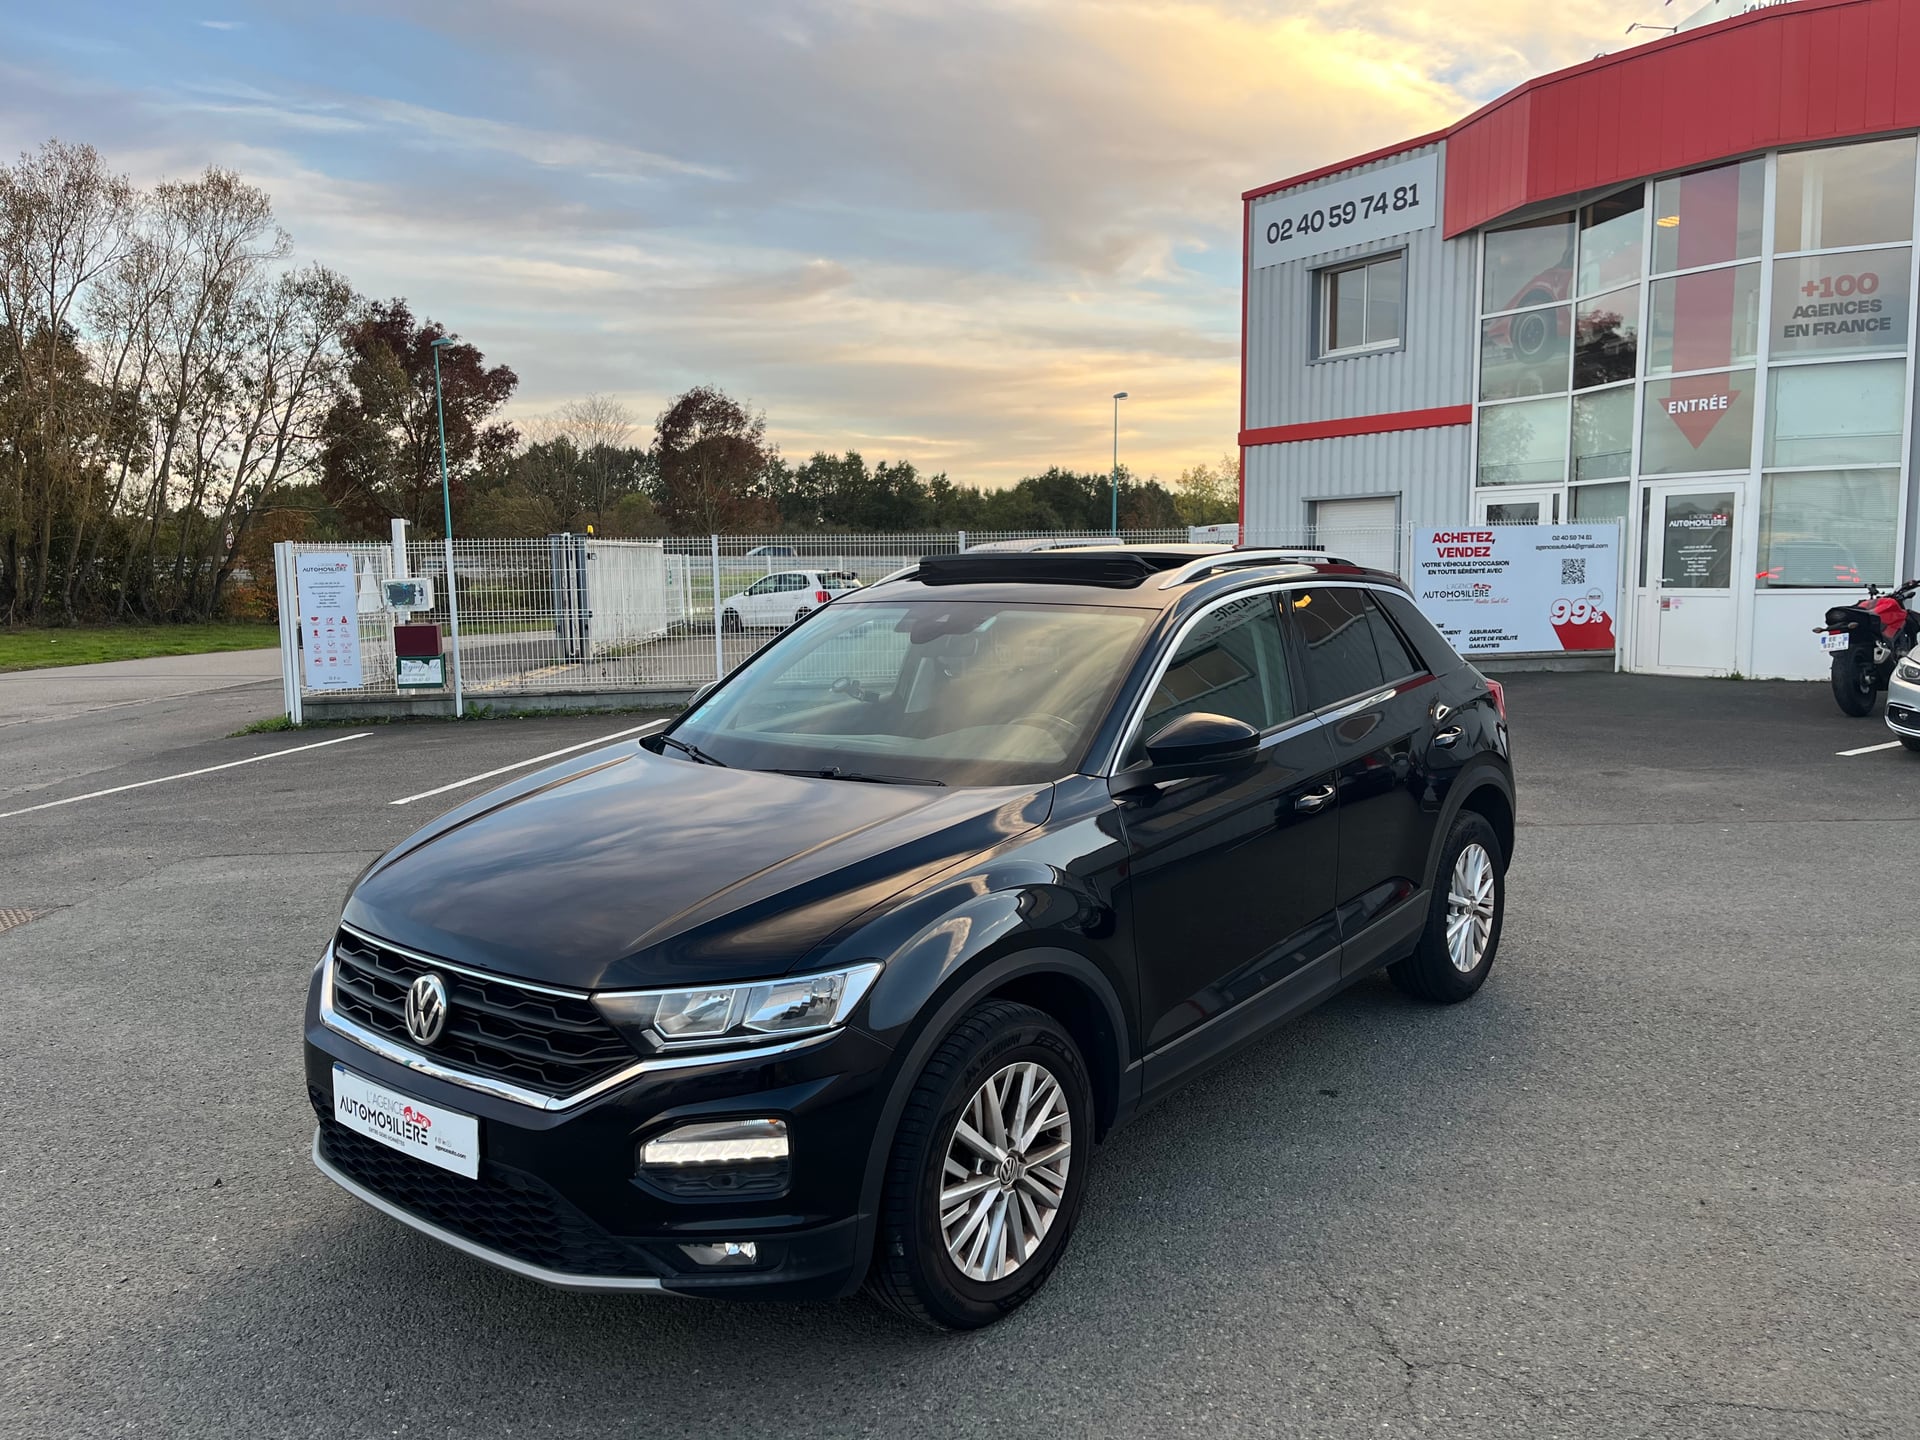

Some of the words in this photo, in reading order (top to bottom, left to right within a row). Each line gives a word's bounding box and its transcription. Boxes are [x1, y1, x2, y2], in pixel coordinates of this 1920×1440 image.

[1267, 217, 1293, 244] 02
[1296, 210, 1325, 236] 40
[1328, 201, 1356, 228] 59
[1360, 191, 1389, 219] 74
[1393, 183, 1419, 211] 81
[1801, 272, 1879, 298] +100
[1792, 299, 1882, 319] AGENCES
[1784, 323, 1809, 338] EN
[1812, 317, 1891, 336] FRANCE
[1668, 394, 1728, 414] ENTRÉE
[1432, 531, 1496, 544] ACHETEZ,
[1437, 546, 1491, 558] VENDEZ
[366, 1090, 404, 1115] L'AGENCE
